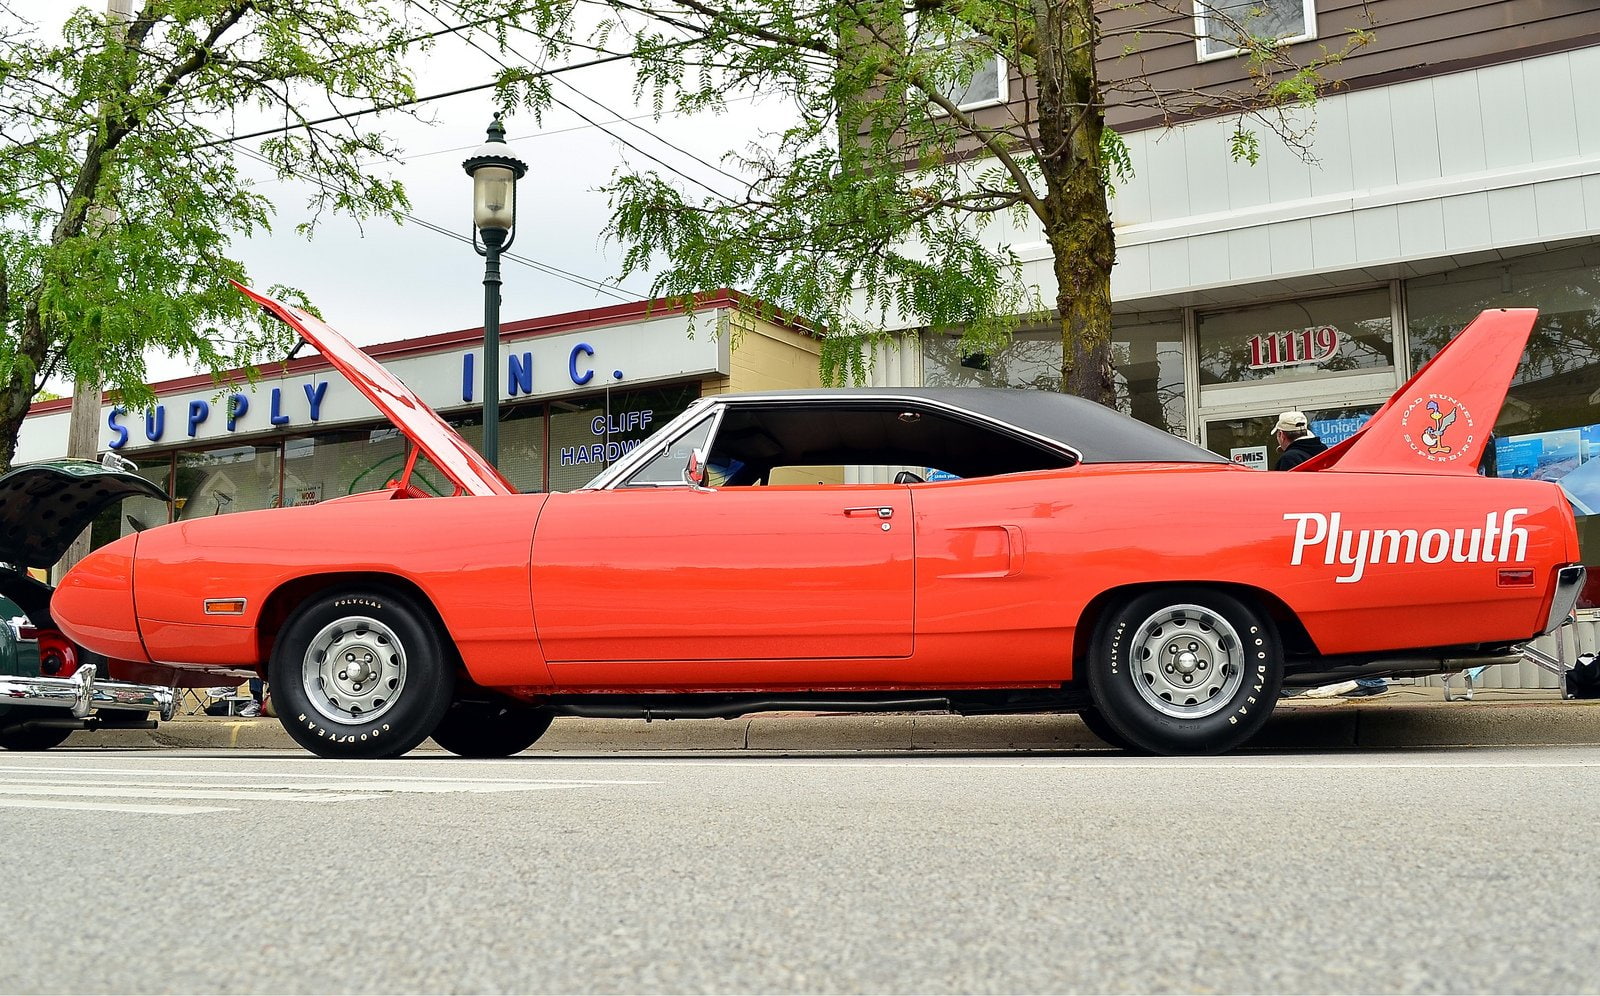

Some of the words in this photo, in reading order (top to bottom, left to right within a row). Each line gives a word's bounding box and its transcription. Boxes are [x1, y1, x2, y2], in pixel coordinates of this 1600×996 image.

[1248, 326, 1339, 369] 11119
[108, 381, 328, 449] SUPPLY
[462, 342, 623, 402] INC.
[1401, 397, 1423, 426] ROAD
[1429, 393, 1474, 427] RUNNER
[591, 409, 653, 435] CLIFF
[1403, 434, 1473, 462] SUPERBIRD
[1283, 508, 1528, 583] Plymouth
[1112, 621, 1126, 674] POLYGLAS
[1228, 625, 1266, 725] GOODYEAR
[298, 713, 390, 743] GOODYEAR
